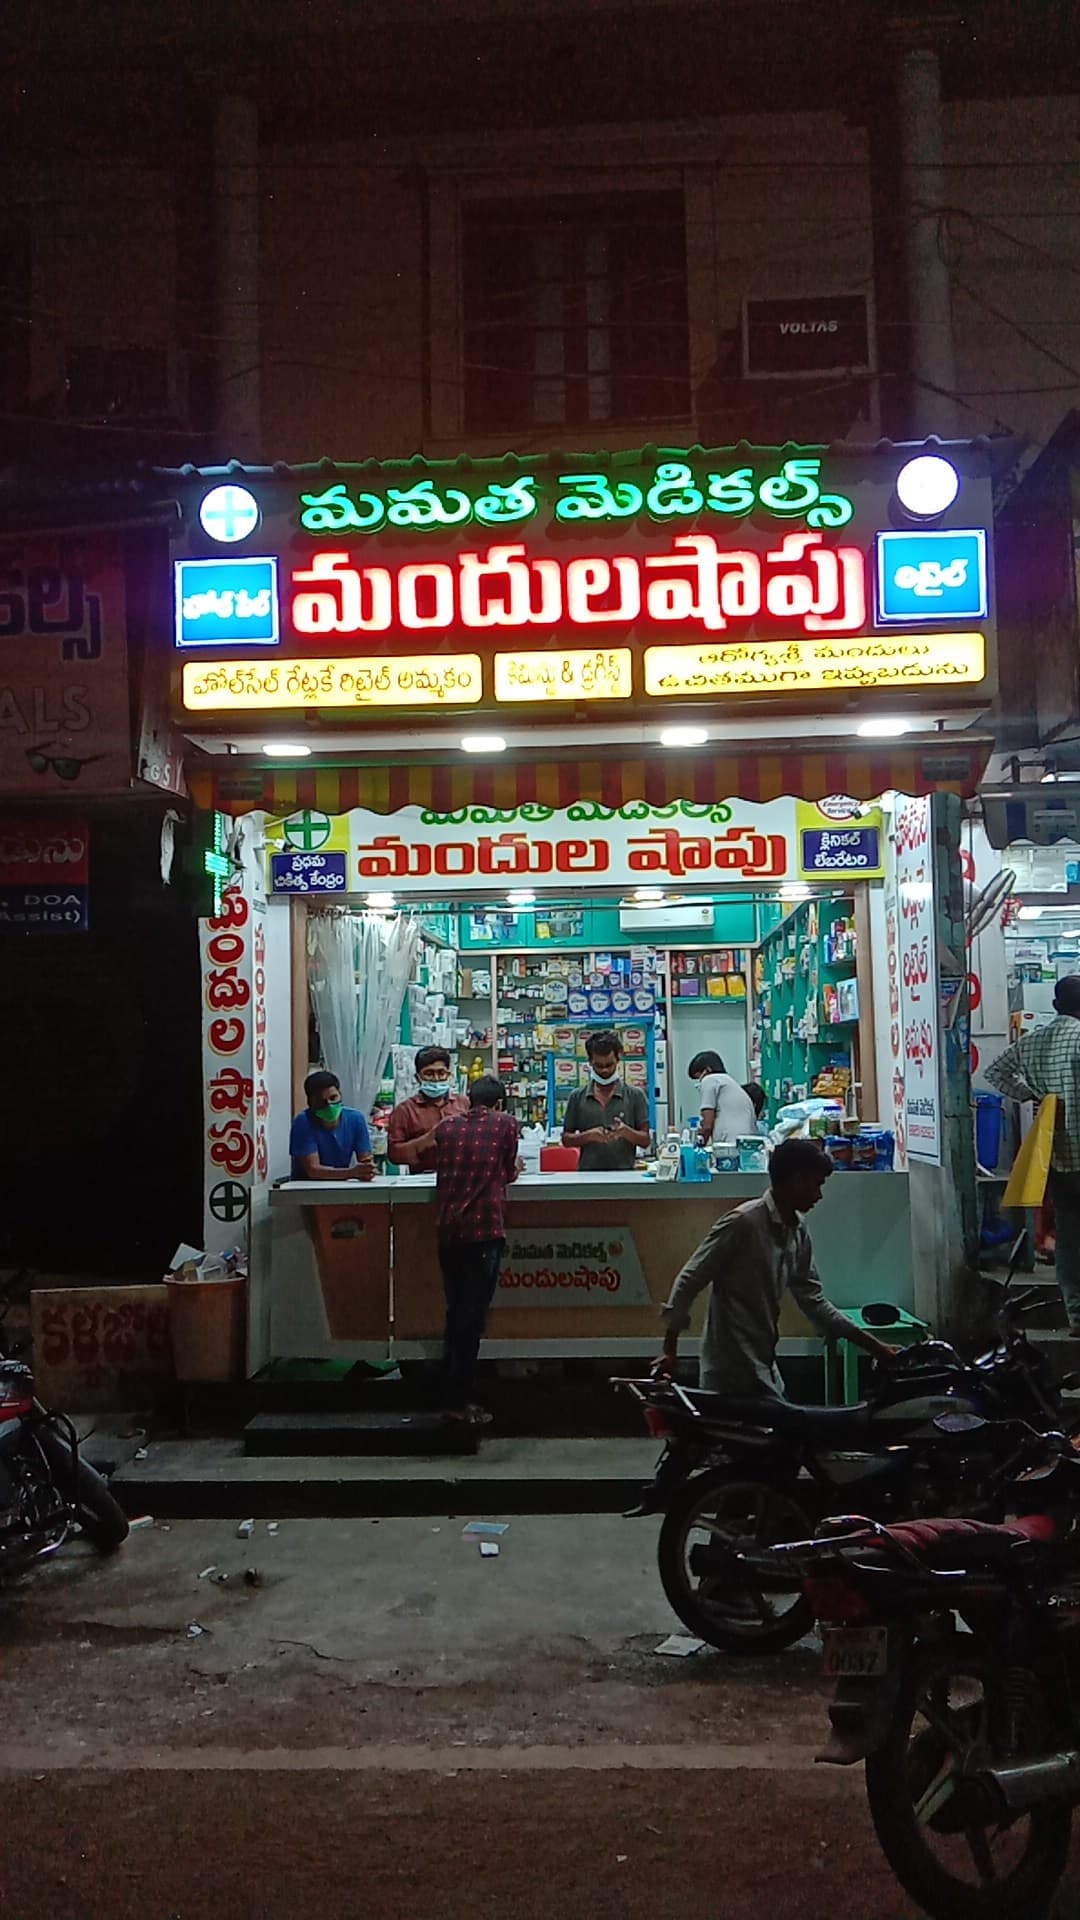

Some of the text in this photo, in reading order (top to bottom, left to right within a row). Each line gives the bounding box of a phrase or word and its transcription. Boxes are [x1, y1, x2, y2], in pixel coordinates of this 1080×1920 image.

[780, 320, 838, 334] VOLTAS
[300, 459, 853, 532] మమత మెడికల్స్
[291, 531, 866, 634] మందులషాపు
[397, 669, 473, 699] అమ్మకం
[561, 660, 574, 683] &
[24, 894, 81, 905] DOA
